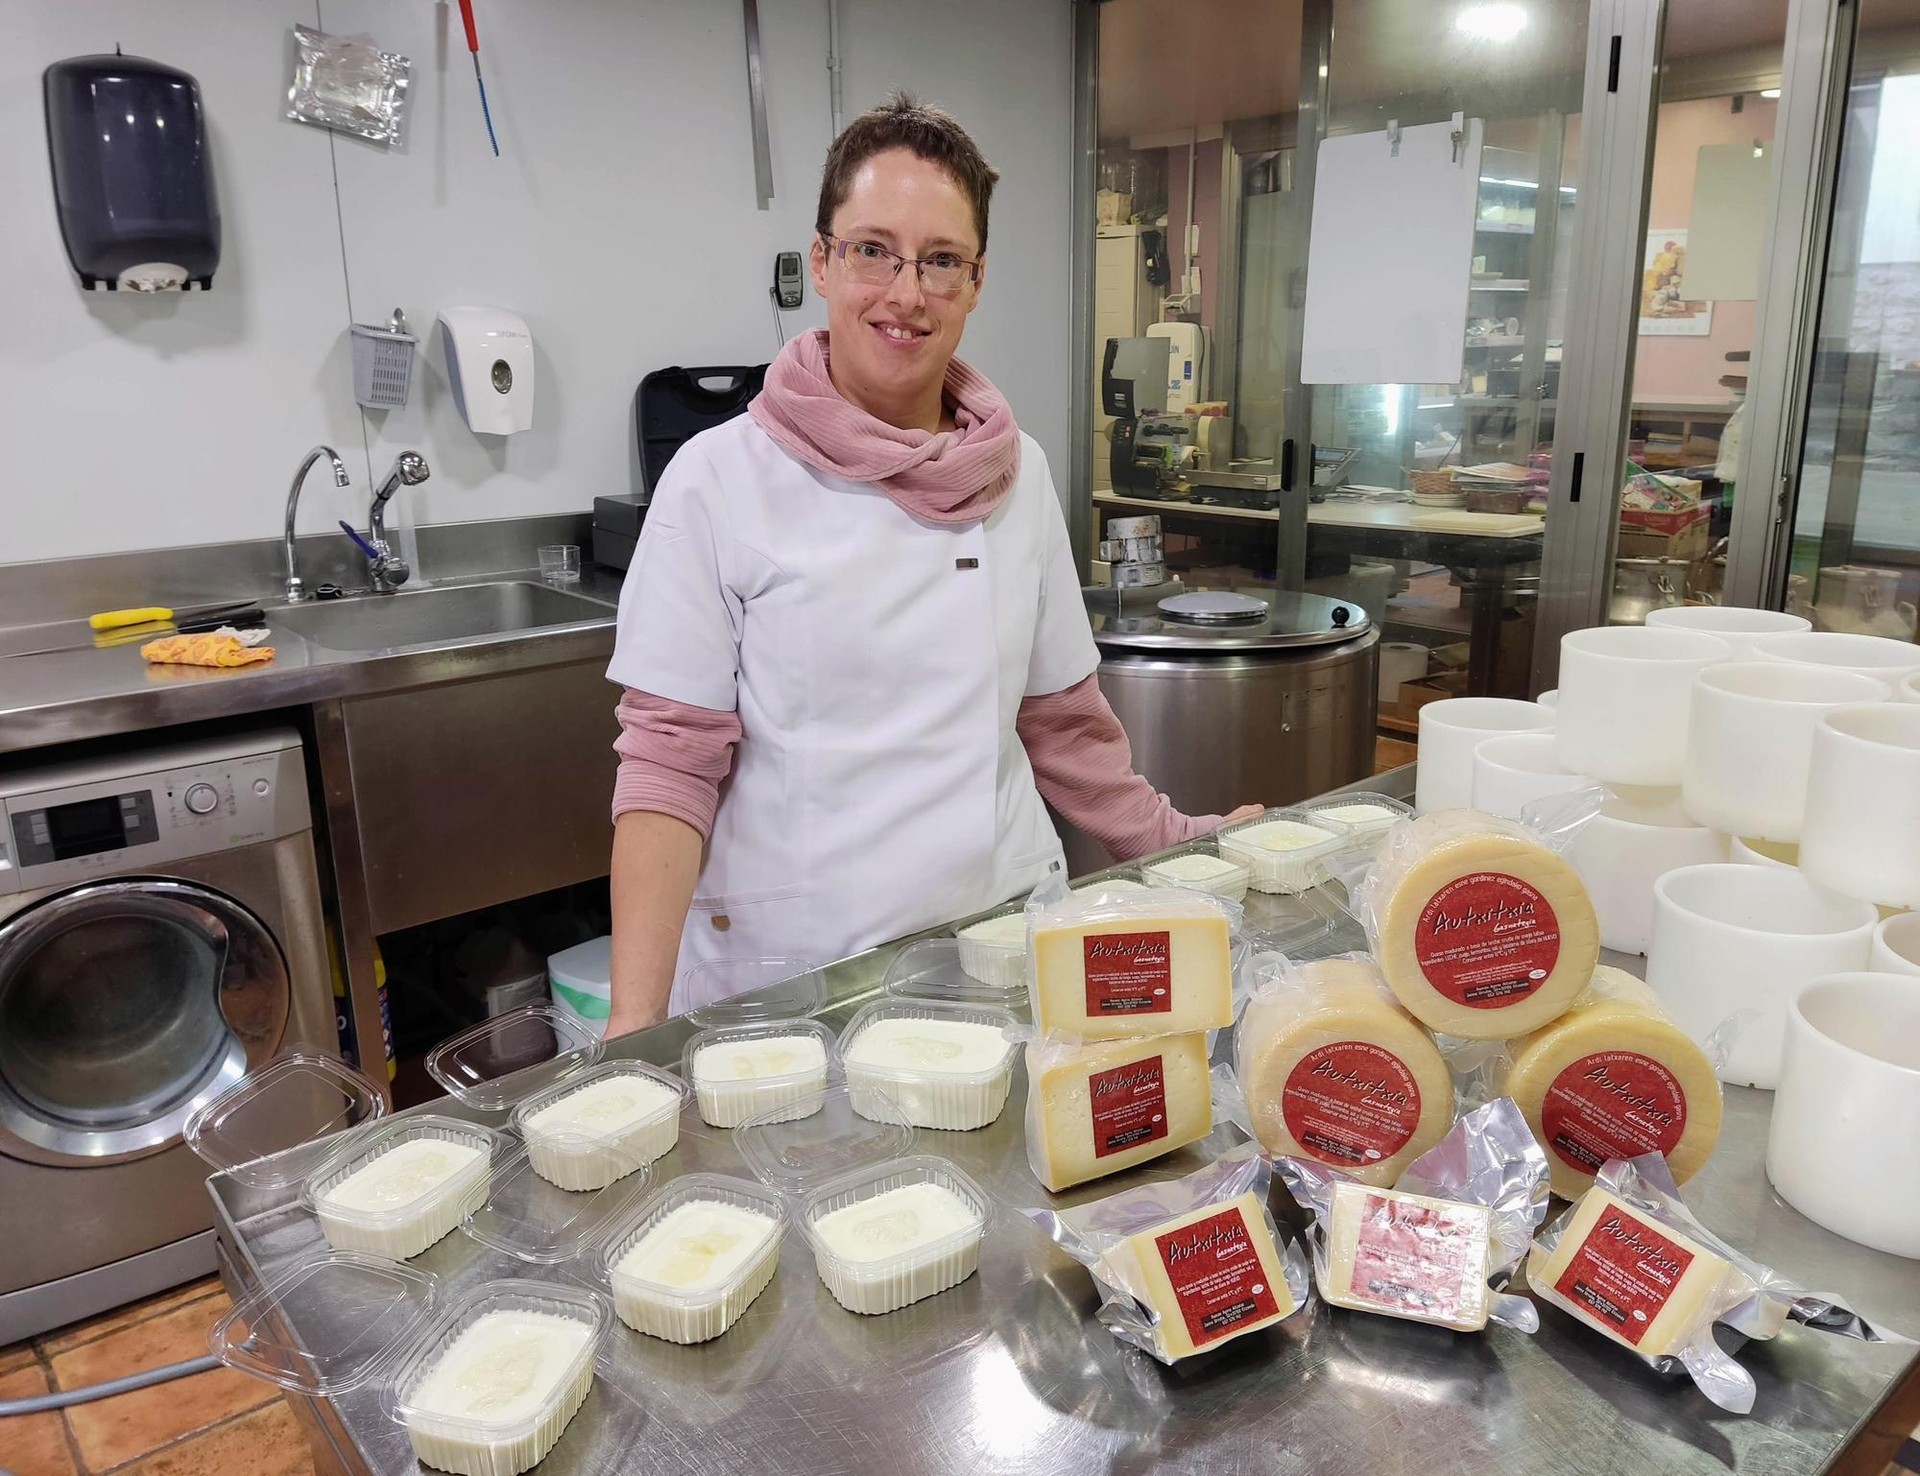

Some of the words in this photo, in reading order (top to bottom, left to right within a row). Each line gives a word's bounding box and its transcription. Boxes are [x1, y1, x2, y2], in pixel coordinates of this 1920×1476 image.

[1423, 909, 1434, 923] Ardi
[1430, 887, 1454, 909] latxaren
[1455, 880, 1469, 889] esne
[1470, 876, 1495, 884] gordinez
